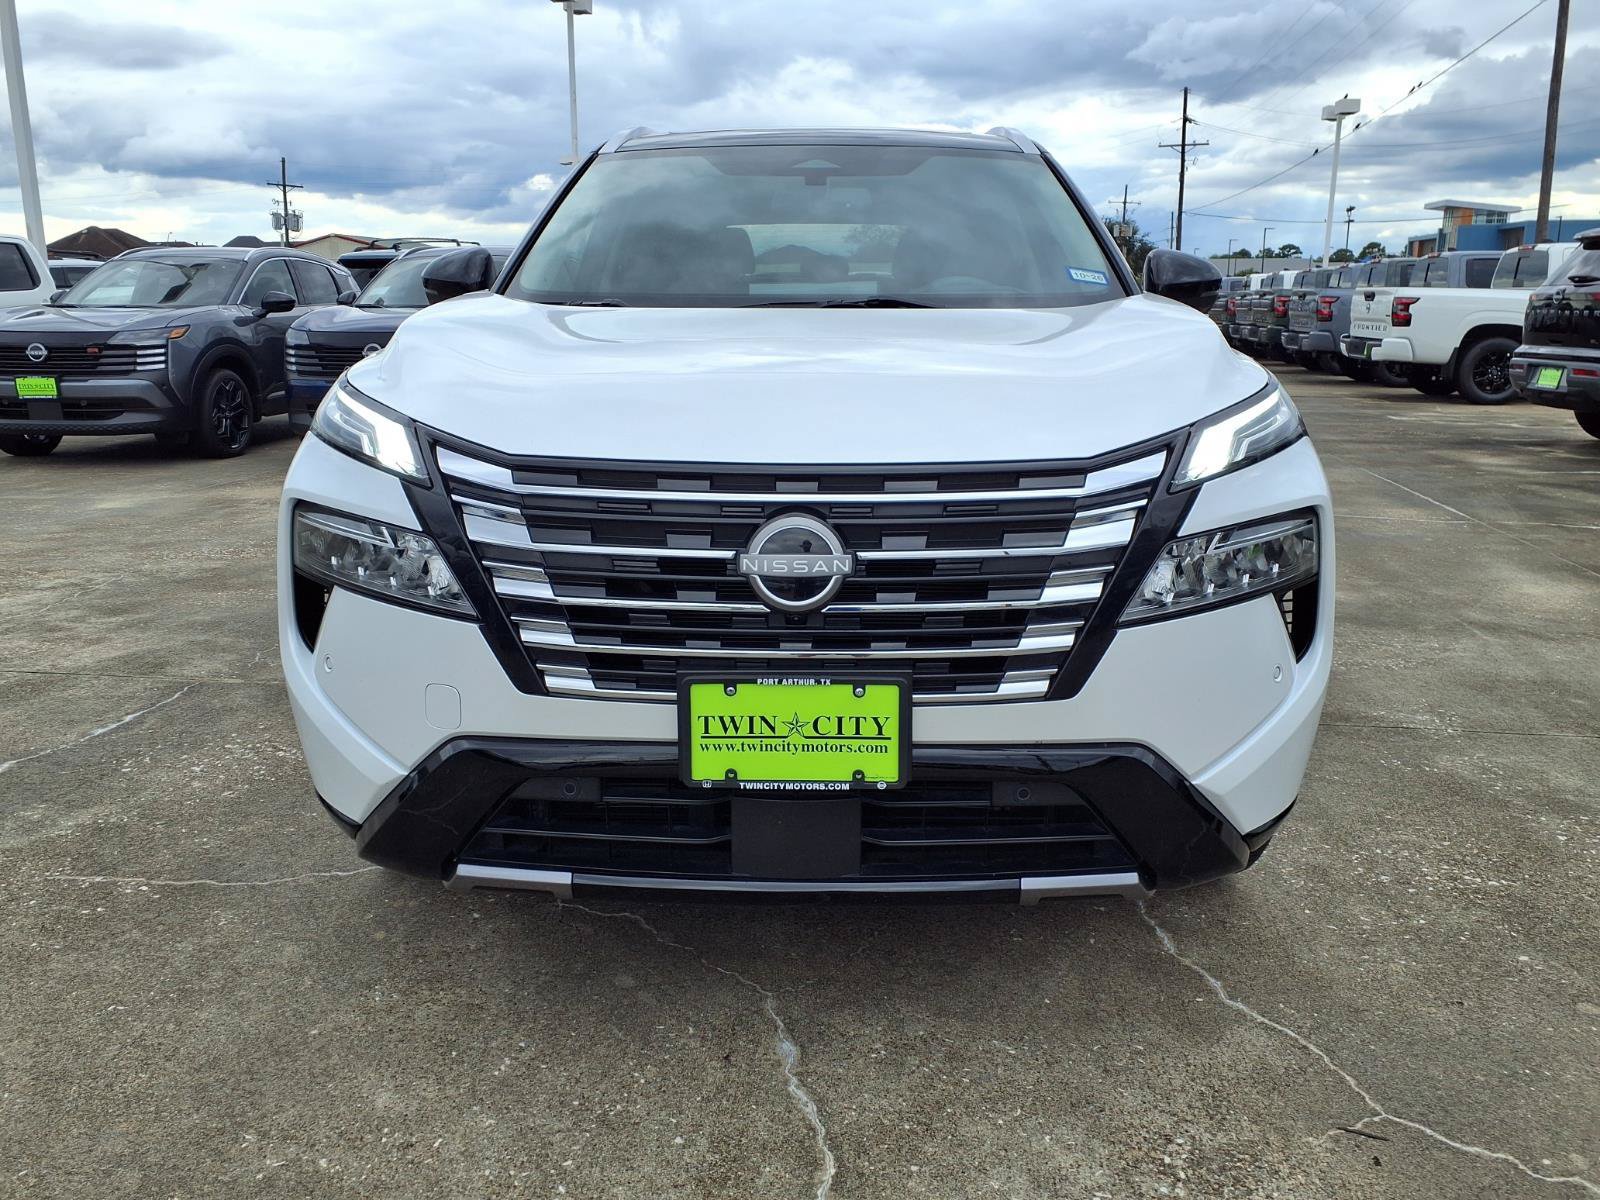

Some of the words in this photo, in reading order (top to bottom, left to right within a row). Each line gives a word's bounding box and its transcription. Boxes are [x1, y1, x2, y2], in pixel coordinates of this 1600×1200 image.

[742, 559, 849, 573] NISSAN
[697, 715, 778, 735] TWIN
[812, 715, 891, 736] CITY
[700, 740, 888, 756] www.twincitymotors.com
[739, 782, 850, 791] TWINCITYMOTORS.COM
